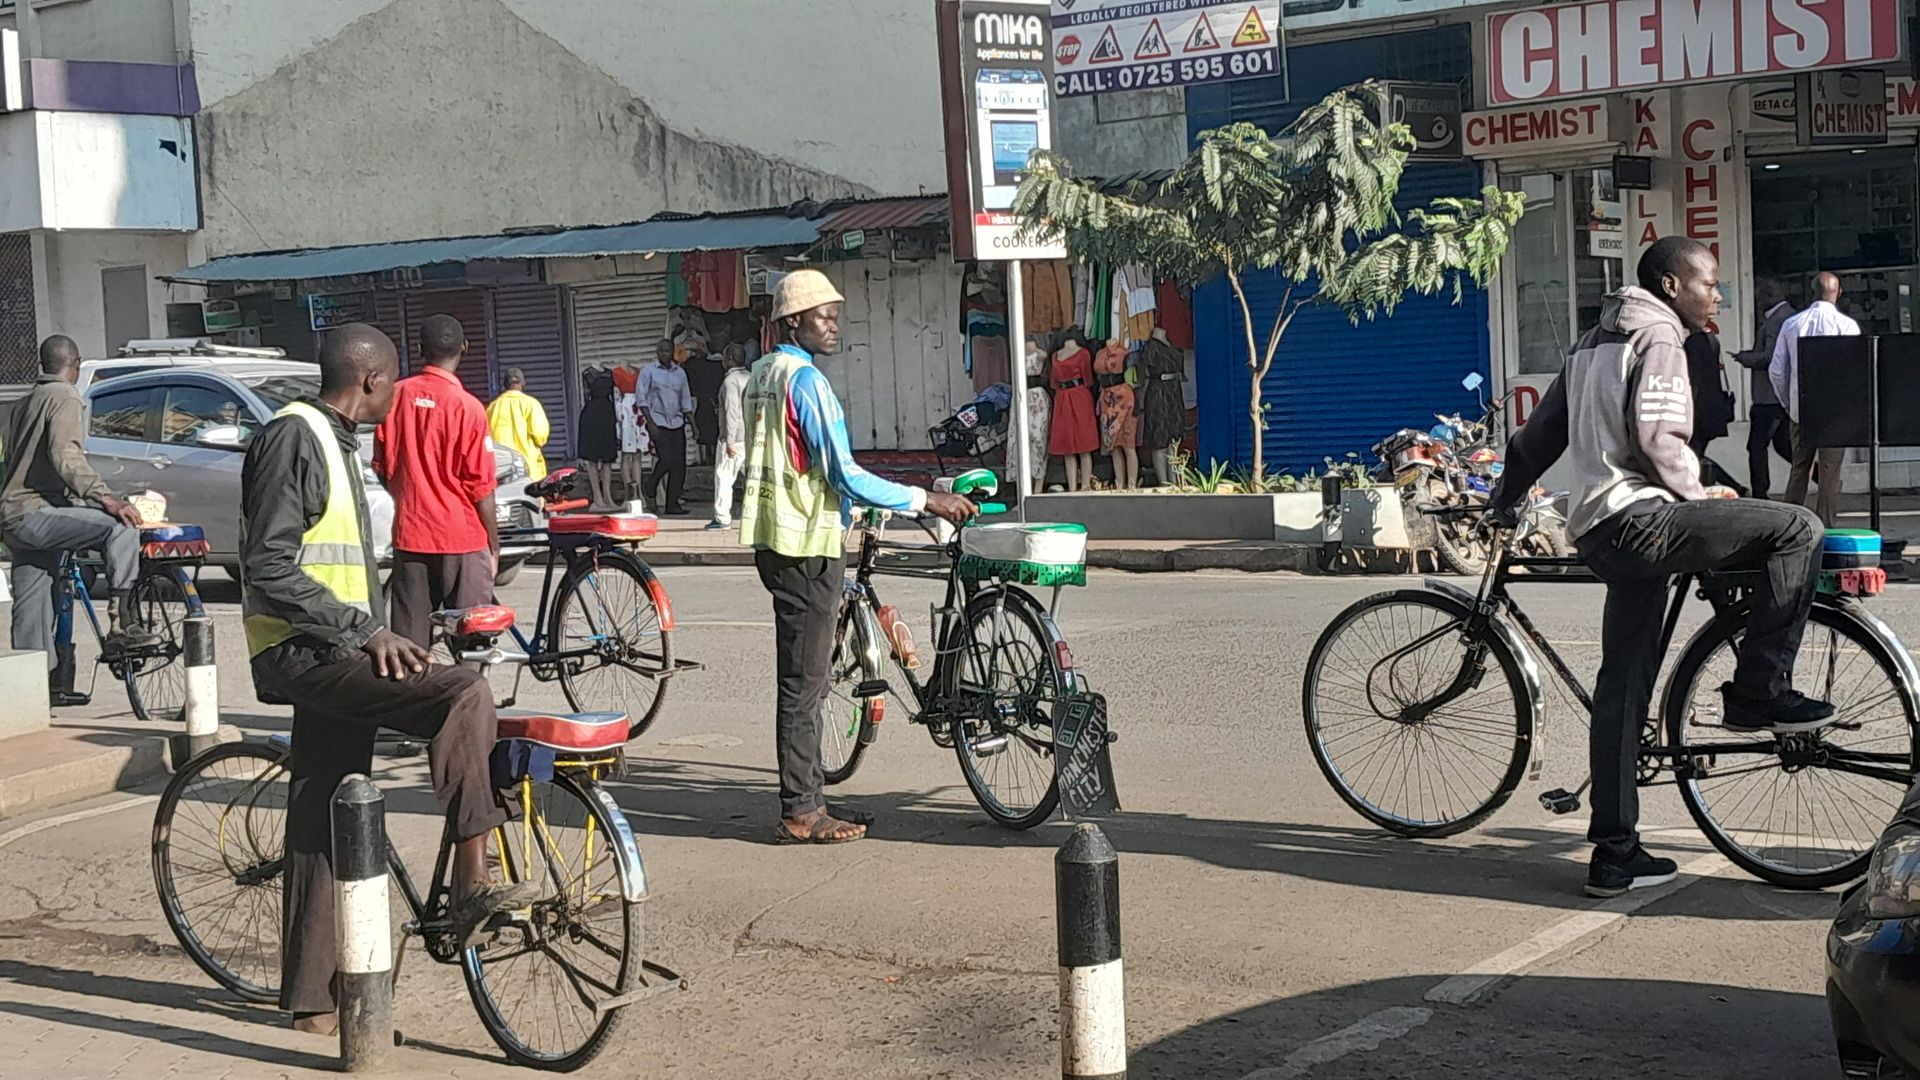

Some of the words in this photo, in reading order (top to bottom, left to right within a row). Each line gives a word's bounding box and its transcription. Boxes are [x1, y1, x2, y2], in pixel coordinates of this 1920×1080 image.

[1071, 10, 1116, 25] LEGALLY
[1119, 0, 1186, 17] REGISTERED
[975, 13, 1043, 46] MIKA
[1056, 43, 1080, 58] STOP
[1500, 0, 1873, 99] CHEMIST
[1054, 70, 1113, 95] CALL:
[1118, 63, 1174, 88] 0725
[1180, 56, 1225, 81] 595
[1230, 51, 1274, 73] 601
[1754, 100, 1781, 111] BETA
[1814, 103, 1883, 134] CHEMIST
[1466, 105, 1601, 146] CHEMIST
[1648, 375, 1684, 393] K-D
[1058, 698, 1107, 792] MANCHESTER
[1069, 765, 1103, 809] CITY
